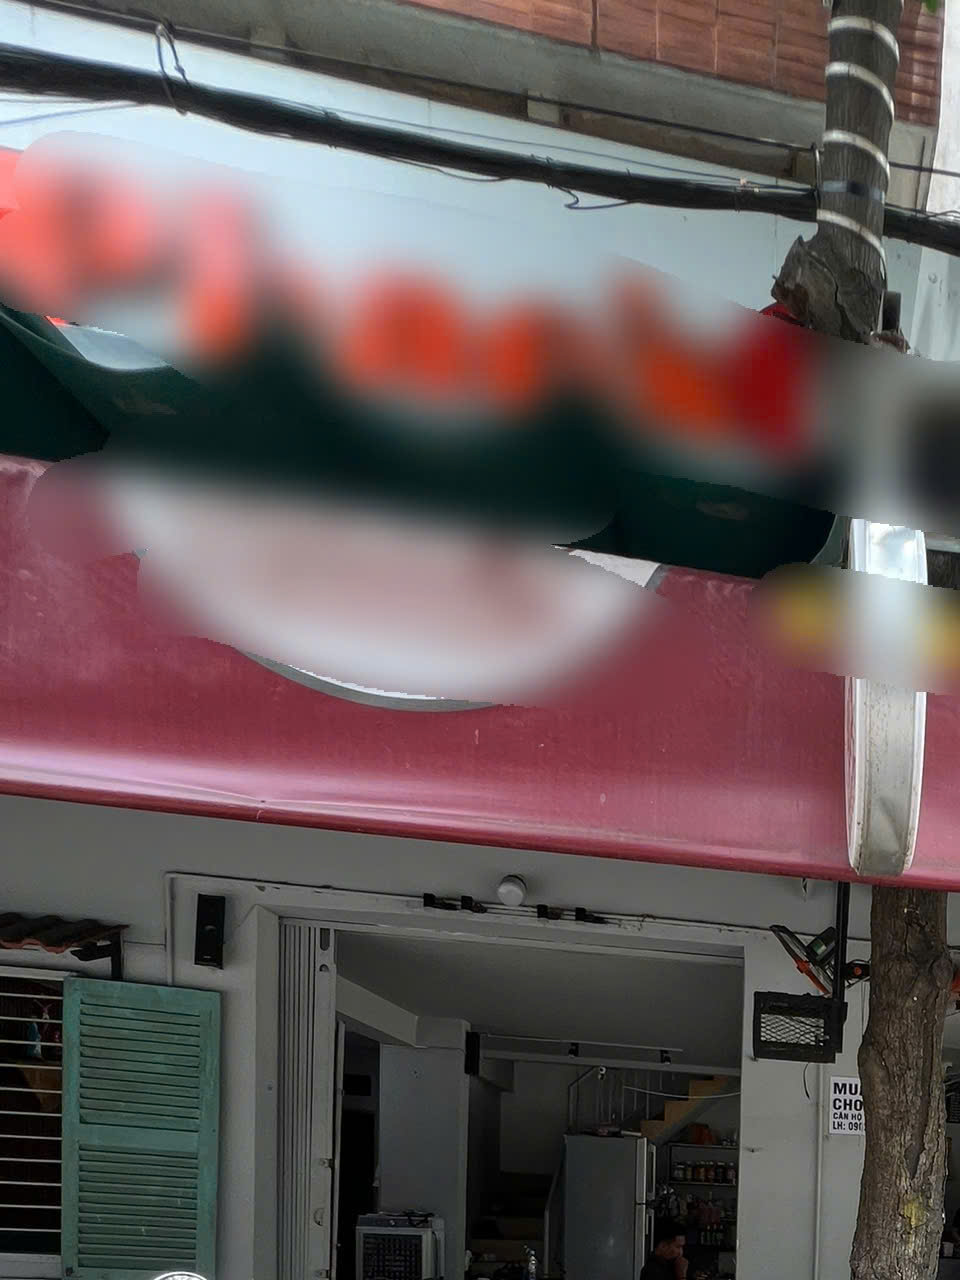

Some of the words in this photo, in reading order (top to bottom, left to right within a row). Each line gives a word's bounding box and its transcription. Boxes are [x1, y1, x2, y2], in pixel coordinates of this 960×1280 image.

[833, 1082, 863, 1096] MU
[833, 1098, 863, 1112] CHO
[832, 1121, 846, 1130] LH:
